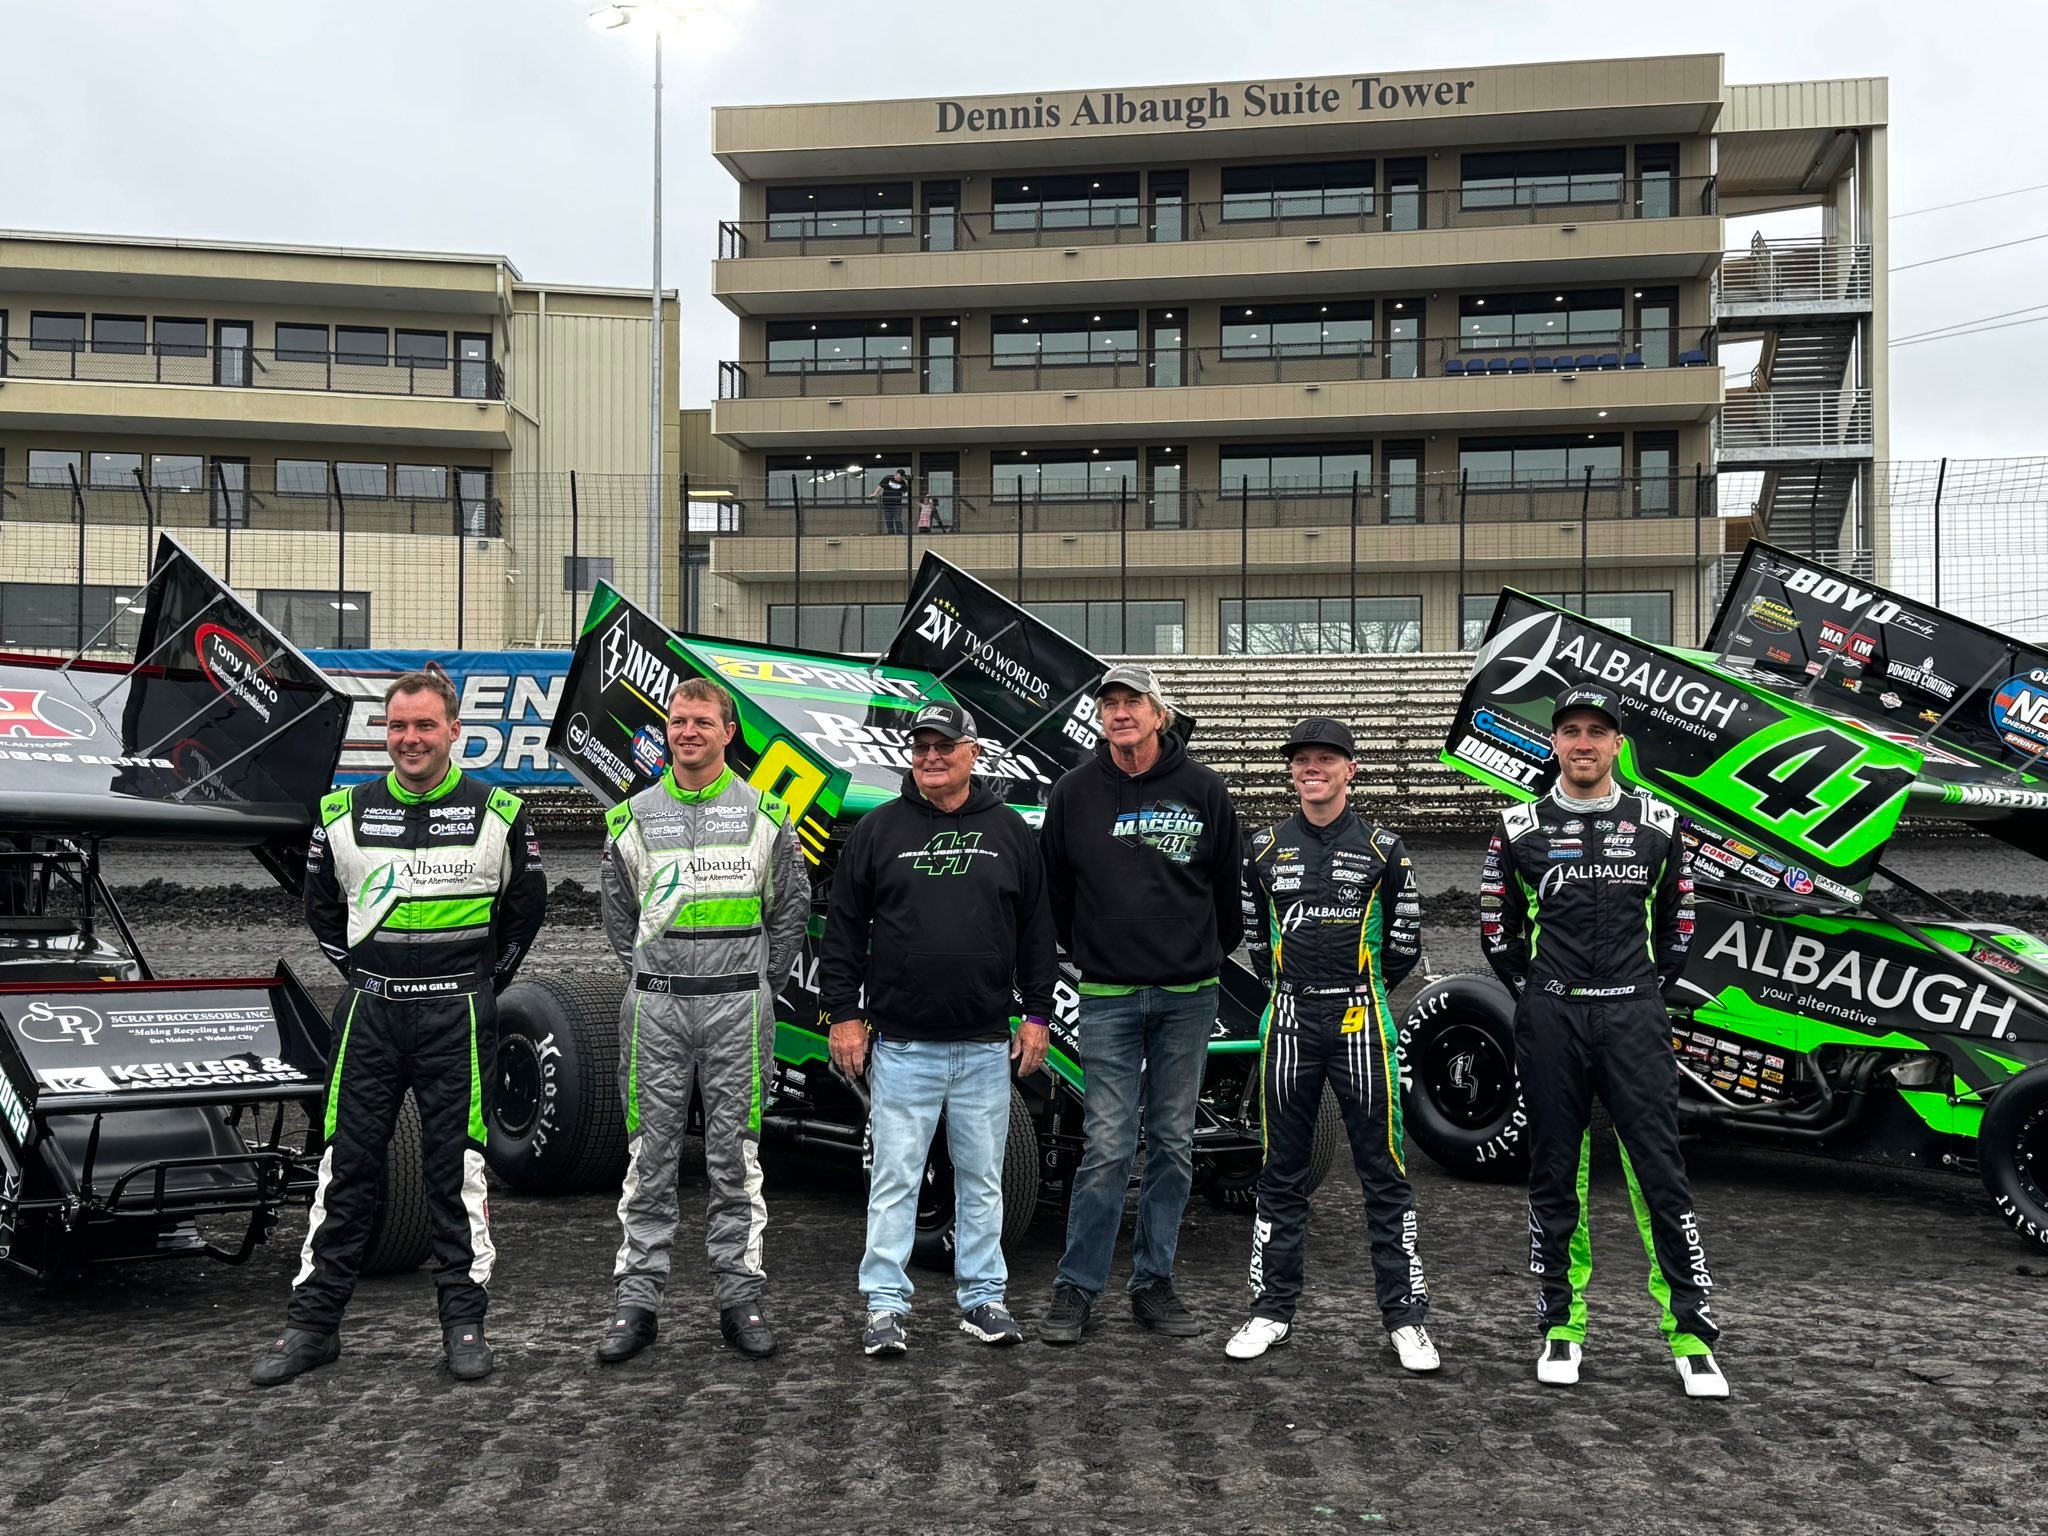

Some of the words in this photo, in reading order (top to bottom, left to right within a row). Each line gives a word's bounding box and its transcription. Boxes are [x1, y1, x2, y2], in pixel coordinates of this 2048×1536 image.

[936, 97, 1061, 133] Dennis
[1070, 93, 1231, 130] Albaugh
[1243, 81, 1340, 119] Suite
[1351, 75, 1475, 112] Tower
[1784, 567, 1902, 625] BOYD
[213, 634, 245, 672] Tony
[245, 663, 278, 704] Moro
[622, 640, 680, 709] INFA
[974, 658, 1028, 700] EQUESTRIAN
[994, 656, 1051, 701] WORLDS
[1556, 634, 1740, 729] ALBAUGH
[1887, 660, 1919, 684] POWDER
[1919, 673, 1957, 700] COATING
[1618, 693, 1649, 713] your
[1650, 704, 1718, 743] alternative
[2001, 716, 2037, 736] ENERGY
[636, 735, 664, 765] NOS
[2005, 733, 2038, 752] SPRINT
[583, 747, 622, 789] SUSPENSION
[588, 735, 636, 785] COMPETITION
[1457, 735, 1546, 786] DURST
[1731, 727, 1918, 853] 41
[364, 807, 406, 817] HICKLIN
[429, 806, 476, 819] BARRON
[704, 805, 748, 817] BARRON
[1152, 811, 1195, 820] CARSON
[429, 823, 475, 835] OMEGA
[705, 820, 749, 832] OMEGA
[1113, 819, 1205, 839] MACEDO
[1690, 822, 1722, 841] HOOSIER
[913, 831, 984, 876] 41
[1156, 834, 1188, 854] 41
[399, 860, 474, 877] Albaugh
[683, 857, 752, 875] Albaugh
[1565, 863, 1649, 881] ALBAUGH
[1743, 867, 1777, 886] COMETIC
[1816, 875, 1847, 893] SMITH
[1305, 906, 1362, 919] ALBAUGH
[393, 982, 428, 993] RYAN
[428, 981, 459, 991] GILES
[1703, 920, 2018, 1040] ALBAUGH
[1579, 986, 1637, 997] MACEDO
[1760, 983, 1794, 1004] your
[1797, 994, 1878, 1028] alternative
[110, 1014, 156, 1025] SCRAP
[157, 1012, 244, 1024] PROCESSORS,
[245, 1010, 273, 1020] INC.
[1339, 1005, 1369, 1034] 9
[166, 1036, 195, 1044] Moines
[237, 1033, 254, 1043] City
[173, 1025, 219, 1037] Recycling
[110, 1058, 251, 1082] KELLER
[260, 1056, 297, 1072] &
[128, 1071, 309, 1090] ASSOCIATES
[532, 1031, 563, 1158] Hoosier
